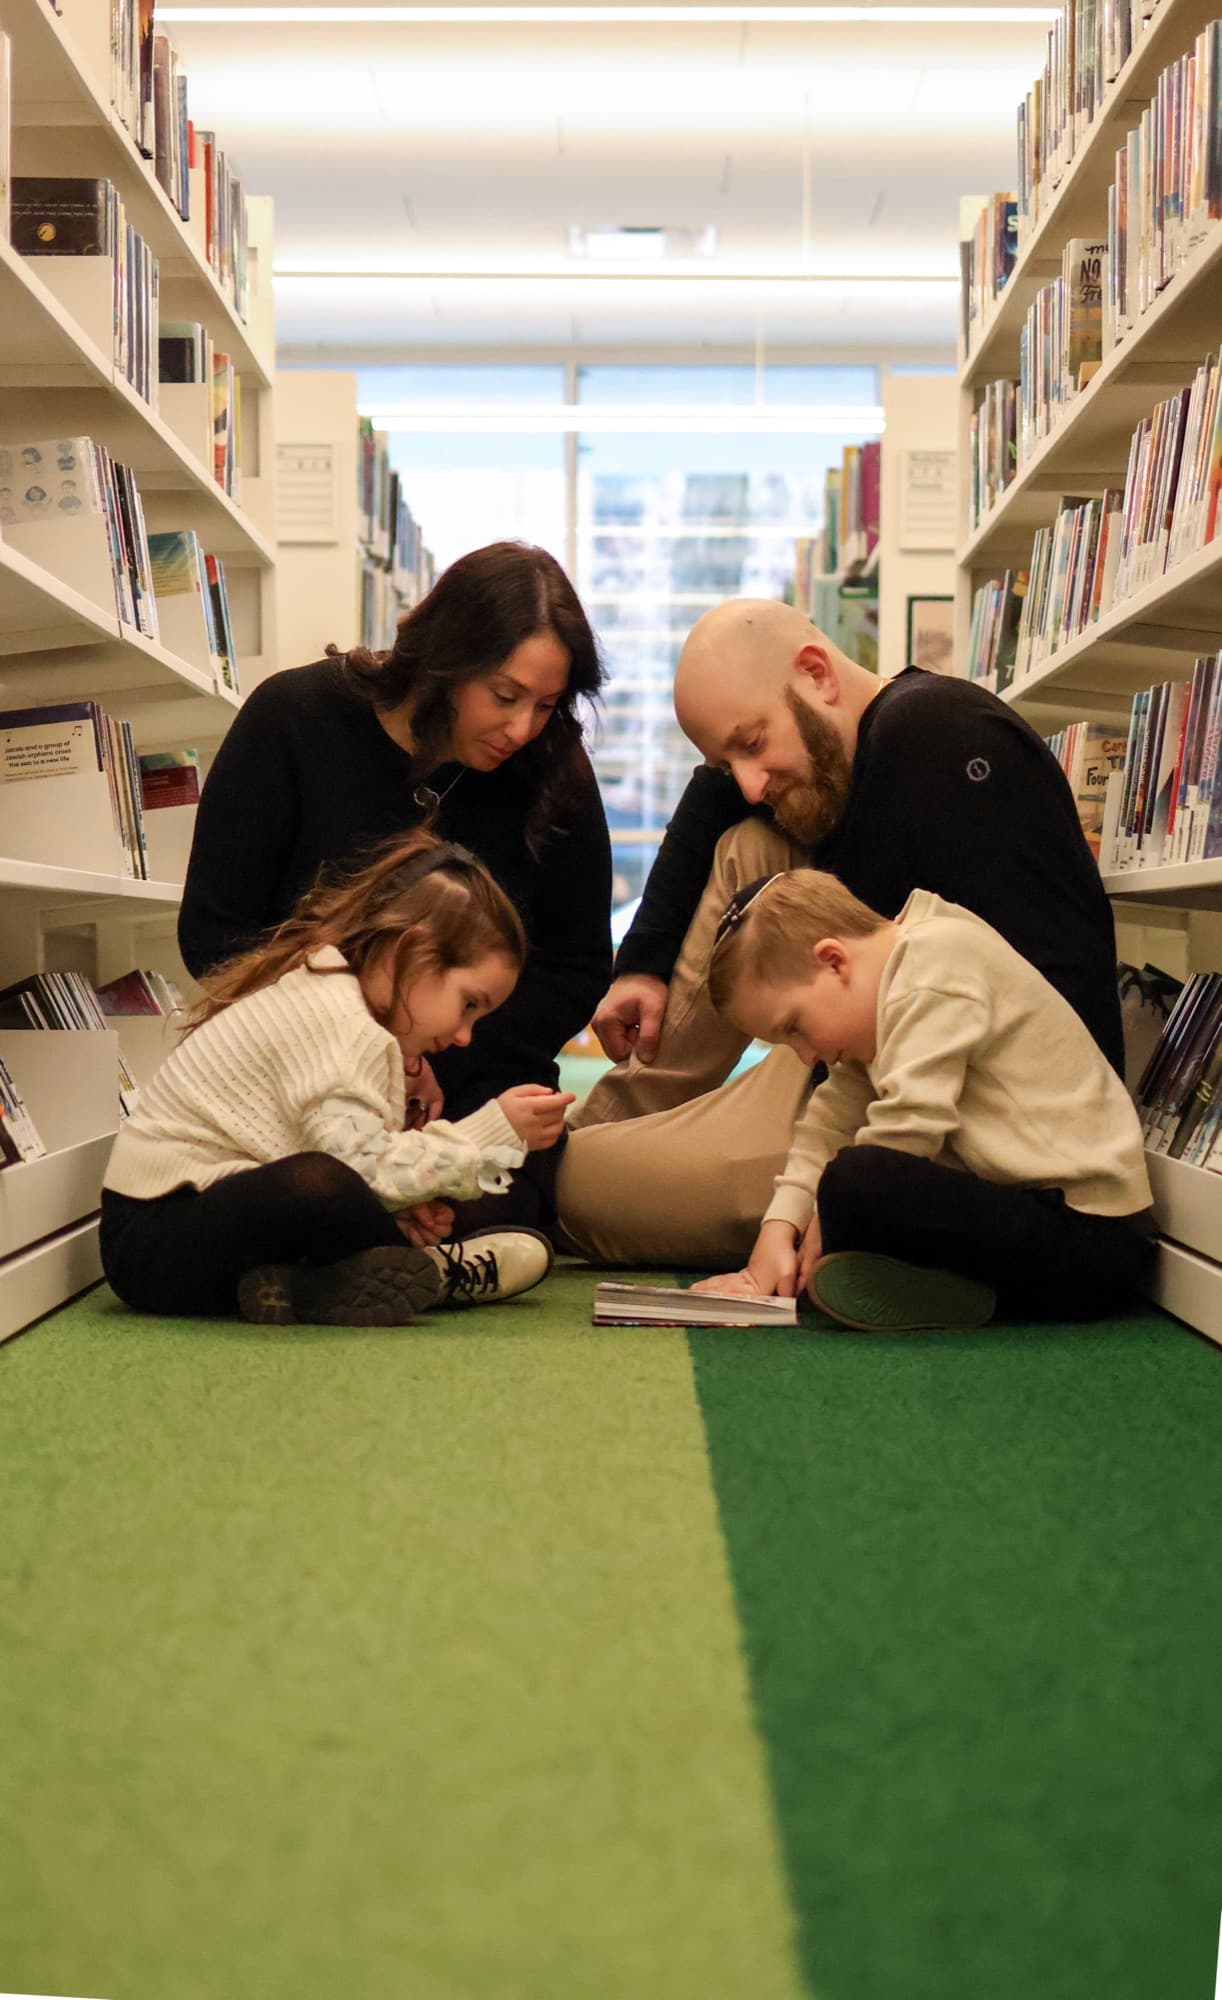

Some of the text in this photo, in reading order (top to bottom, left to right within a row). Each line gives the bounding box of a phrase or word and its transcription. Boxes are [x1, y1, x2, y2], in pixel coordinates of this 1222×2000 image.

[44, 742, 63, 750] group
[5, 753, 27, 761] Jewish
[27, 750, 53, 759] orphans
